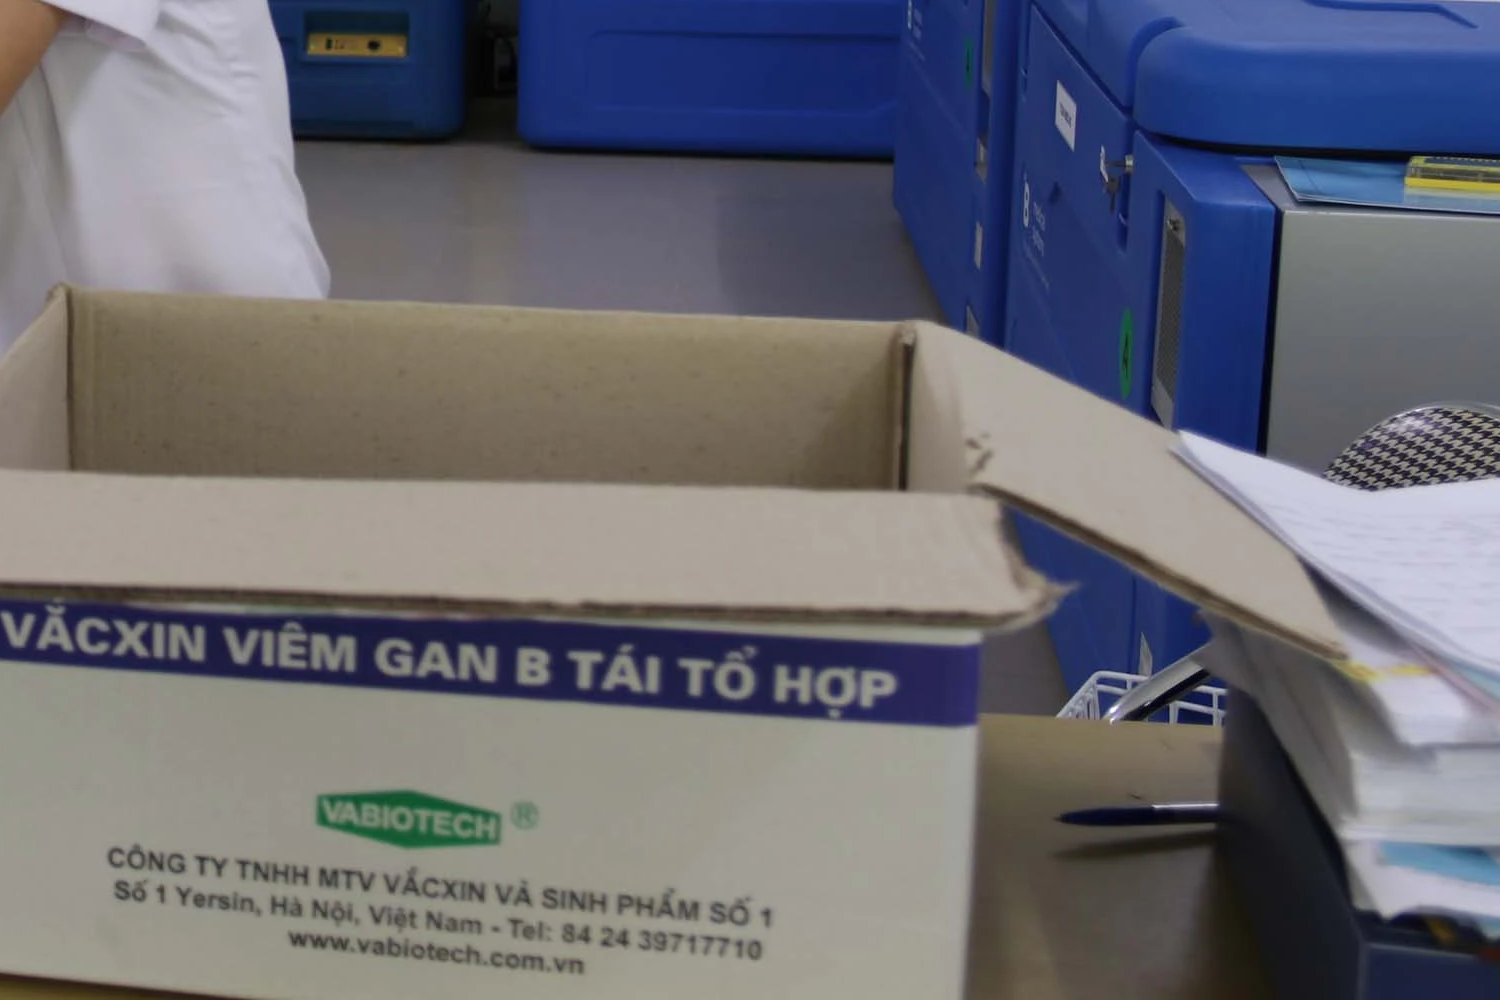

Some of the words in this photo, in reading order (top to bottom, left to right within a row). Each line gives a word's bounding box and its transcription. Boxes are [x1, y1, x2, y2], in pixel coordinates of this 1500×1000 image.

[224, 623, 357, 673] VIÊM
[374, 638, 498, 684] GAN
[516, 646, 551, 686] B
[567, 643, 662, 695] TÁI
[678, 645, 758, 701] TỔ
[773, 664, 898, 721] HỢP
[322, 800, 499, 840] VABIOTECH
[107, 844, 187, 874] CÔNG
[194, 855, 228, 878] TY
[235, 859, 310, 888] TNHH
[318, 866, 376, 893] MTV
[541, 887, 607, 914] SINH
[617, 886, 700, 921] PHẨM
[709, 895, 752, 926] SỐ
[760, 907, 772, 928] 1
[114, 880, 148, 903] Số
[156, 884, 166, 904] 1
[175, 886, 262, 917] Yersin,
[270, 895, 304, 918] Hà
[311, 898, 361, 927] Nội,
[368, 903, 418, 933] Việt
[425, 909, 483, 935] Nam
[507, 916, 554, 943] Tel:
[562, 923, 591, 944] 84
[600, 926, 630, 948] 24
[638, 929, 763, 961] 39717710
[288, 930, 586, 975] www.vabiotech.com.vn
